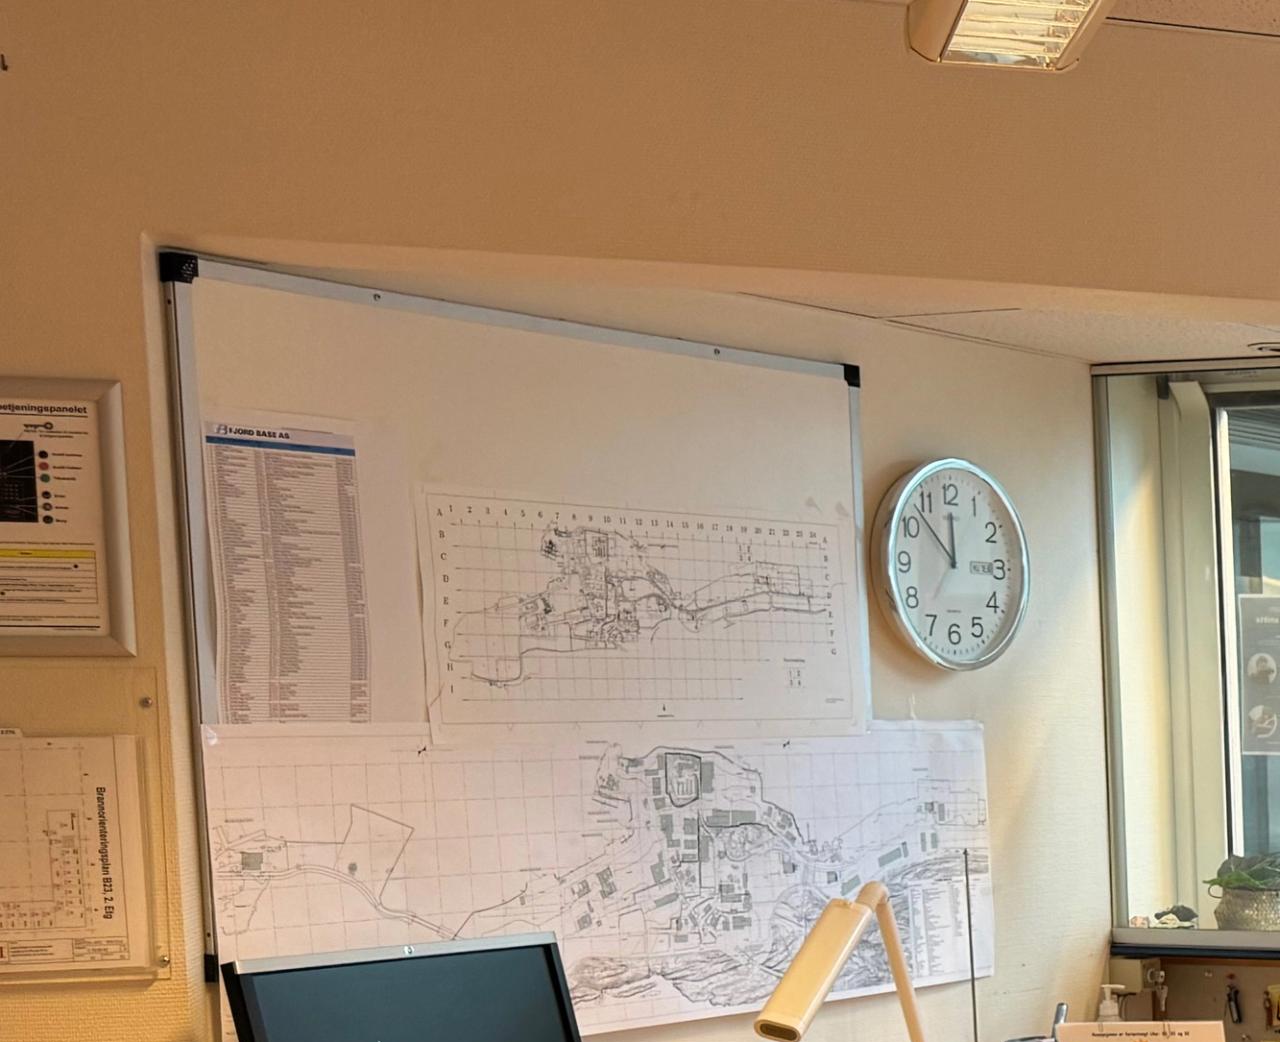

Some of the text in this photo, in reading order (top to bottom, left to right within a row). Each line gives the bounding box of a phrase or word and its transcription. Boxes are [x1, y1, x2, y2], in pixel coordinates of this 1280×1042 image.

[920, 491, 932, 513] 11
[943, 483, 959, 506] 12
[437, 508, 443, 517] A
[971, 496, 977, 517] 1
[439, 530, 445, 539] B
[902, 515, 920, 538] 10
[985, 521, 997, 543] 2
[440, 552, 447, 561] C
[897, 550, 912, 573] 9
[443, 574, 449, 583] D
[993, 559, 1006, 580] 3
[443, 596, 449, 605] E
[905, 586, 919, 609] 8
[986, 591, 1000, 614] 4
[443, 619, 449, 628] F
[924, 614, 938, 636] 7
[971, 616, 984, 639] 5
[444, 641, 451, 649] G
[948, 623, 962, 646] 6
[447, 663, 454, 671] H
